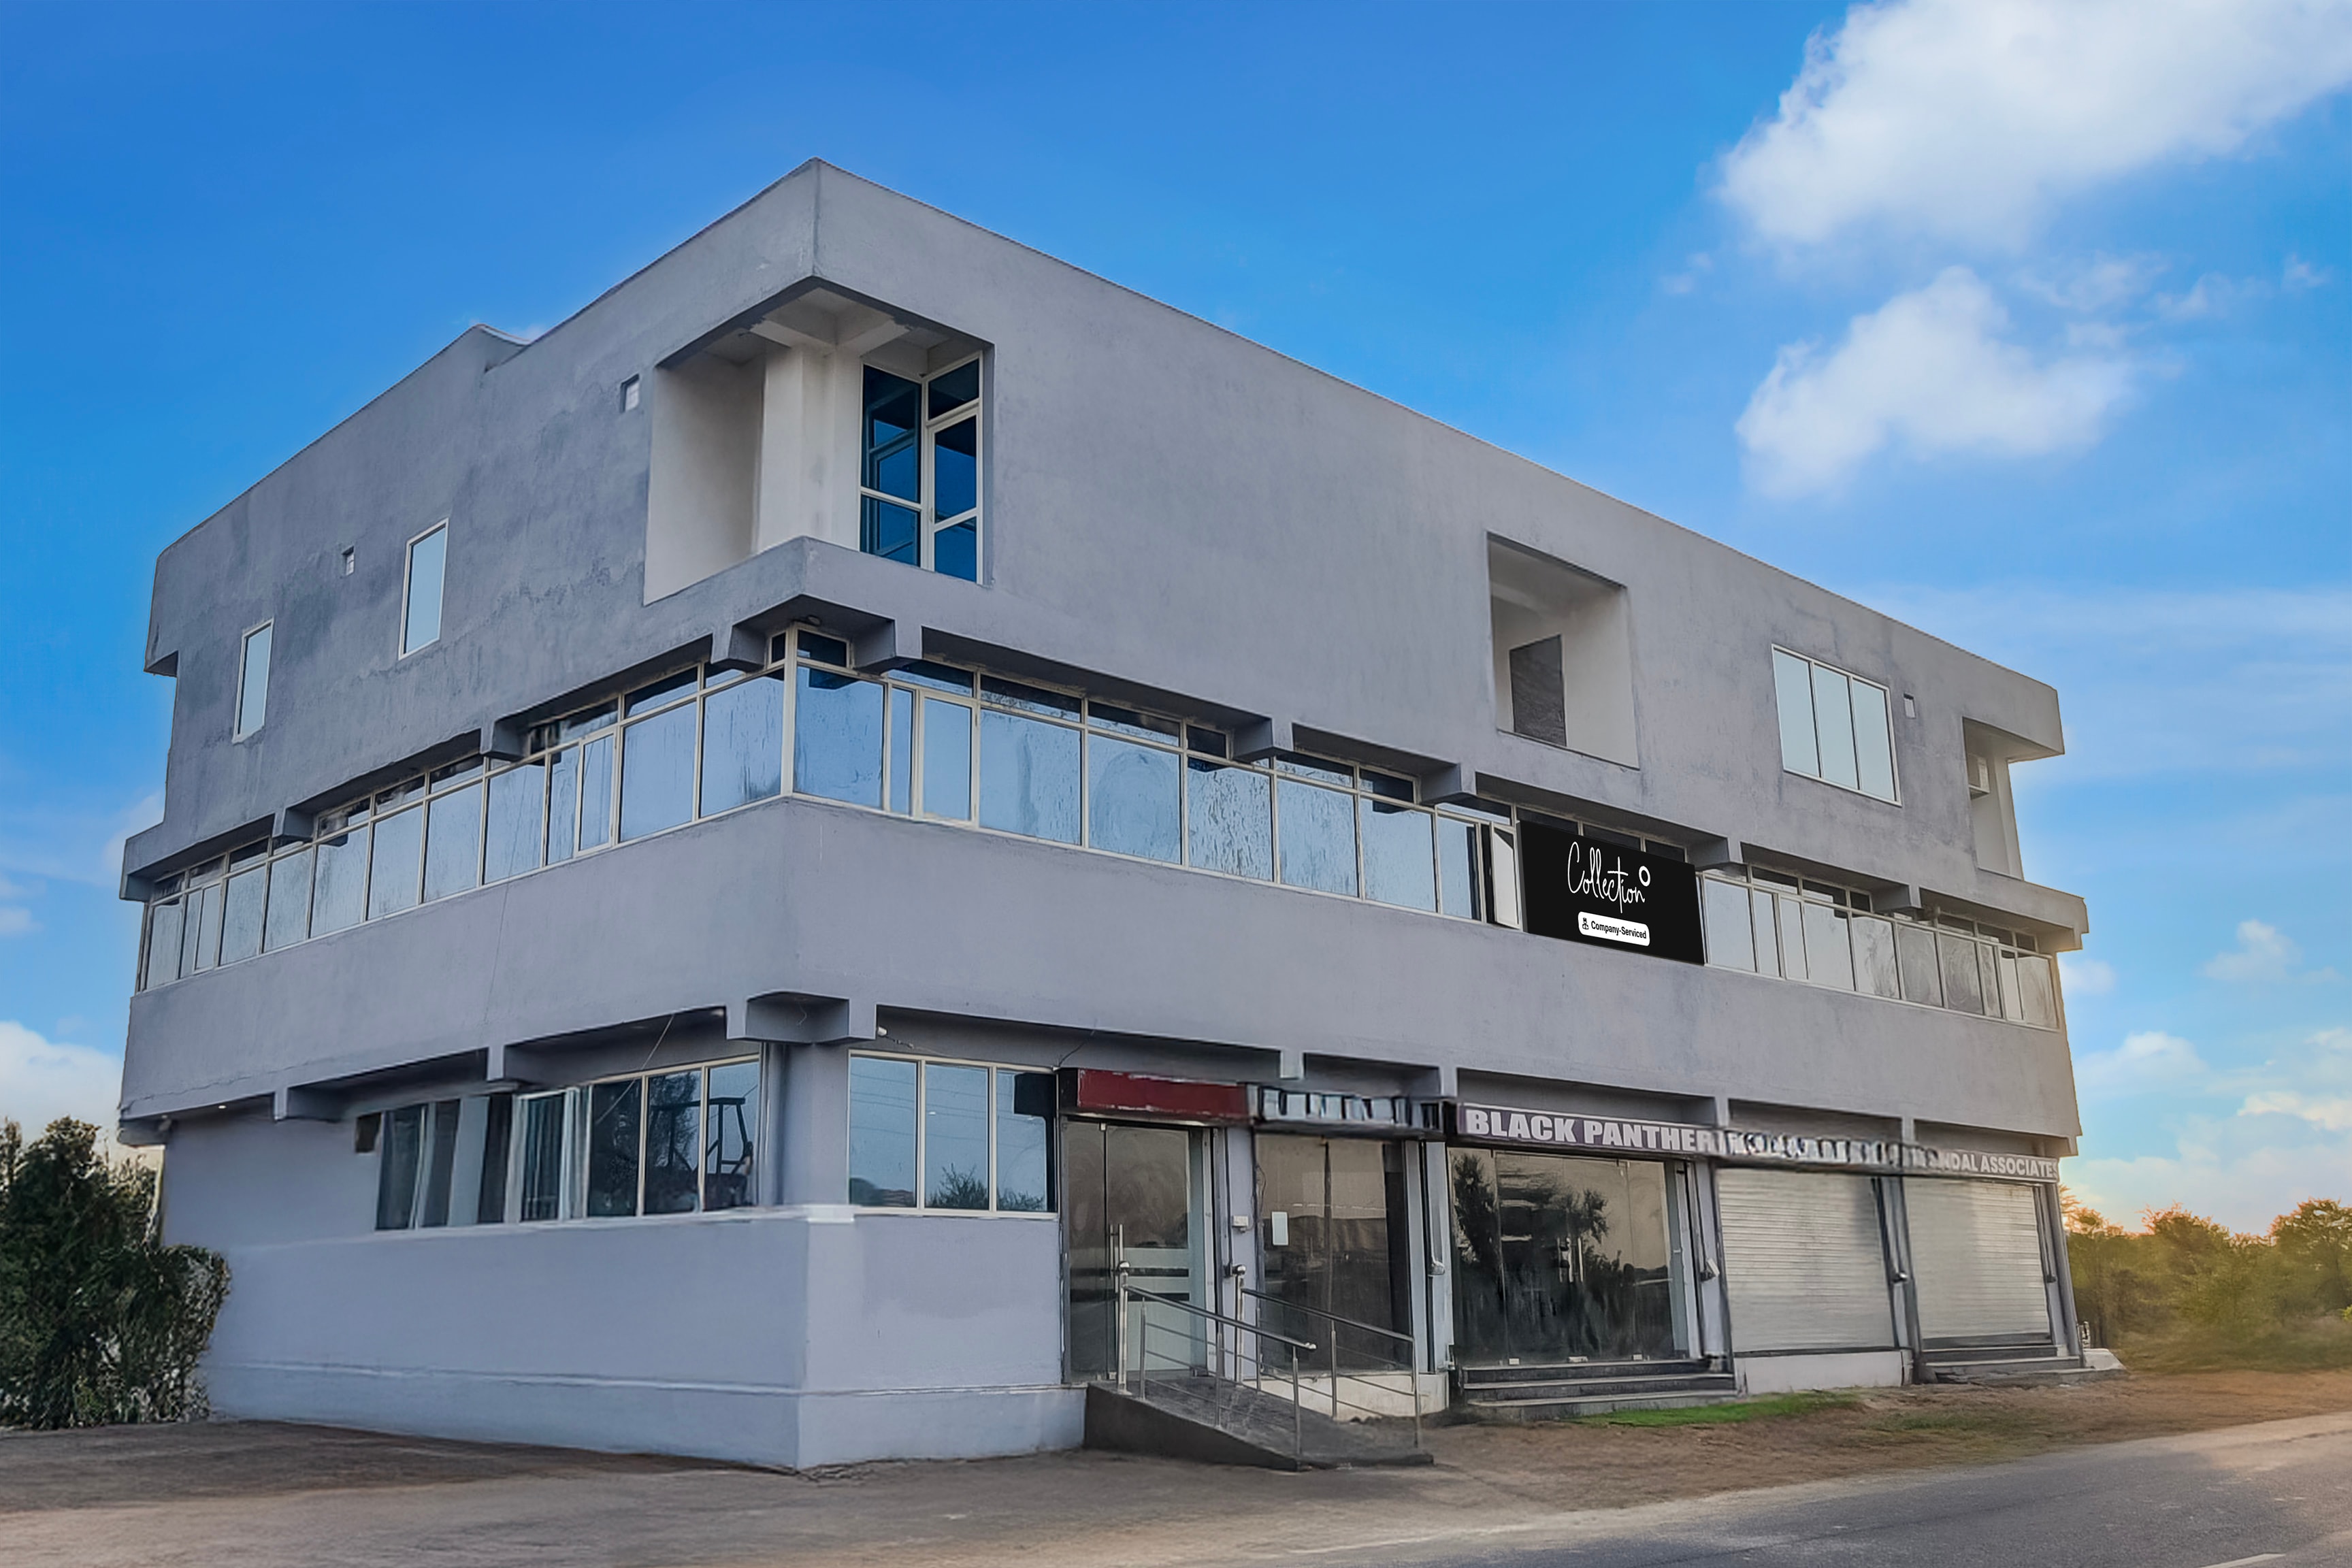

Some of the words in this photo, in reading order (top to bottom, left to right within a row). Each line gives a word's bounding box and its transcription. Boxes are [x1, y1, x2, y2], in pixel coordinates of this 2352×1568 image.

[1567, 841, 1646, 913] Collection
[1591, 921, 1647, 939] Company-Serviced
[1465, 1109, 1576, 1143] BLACK
[1584, 1120, 1717, 1153] PANTHER
